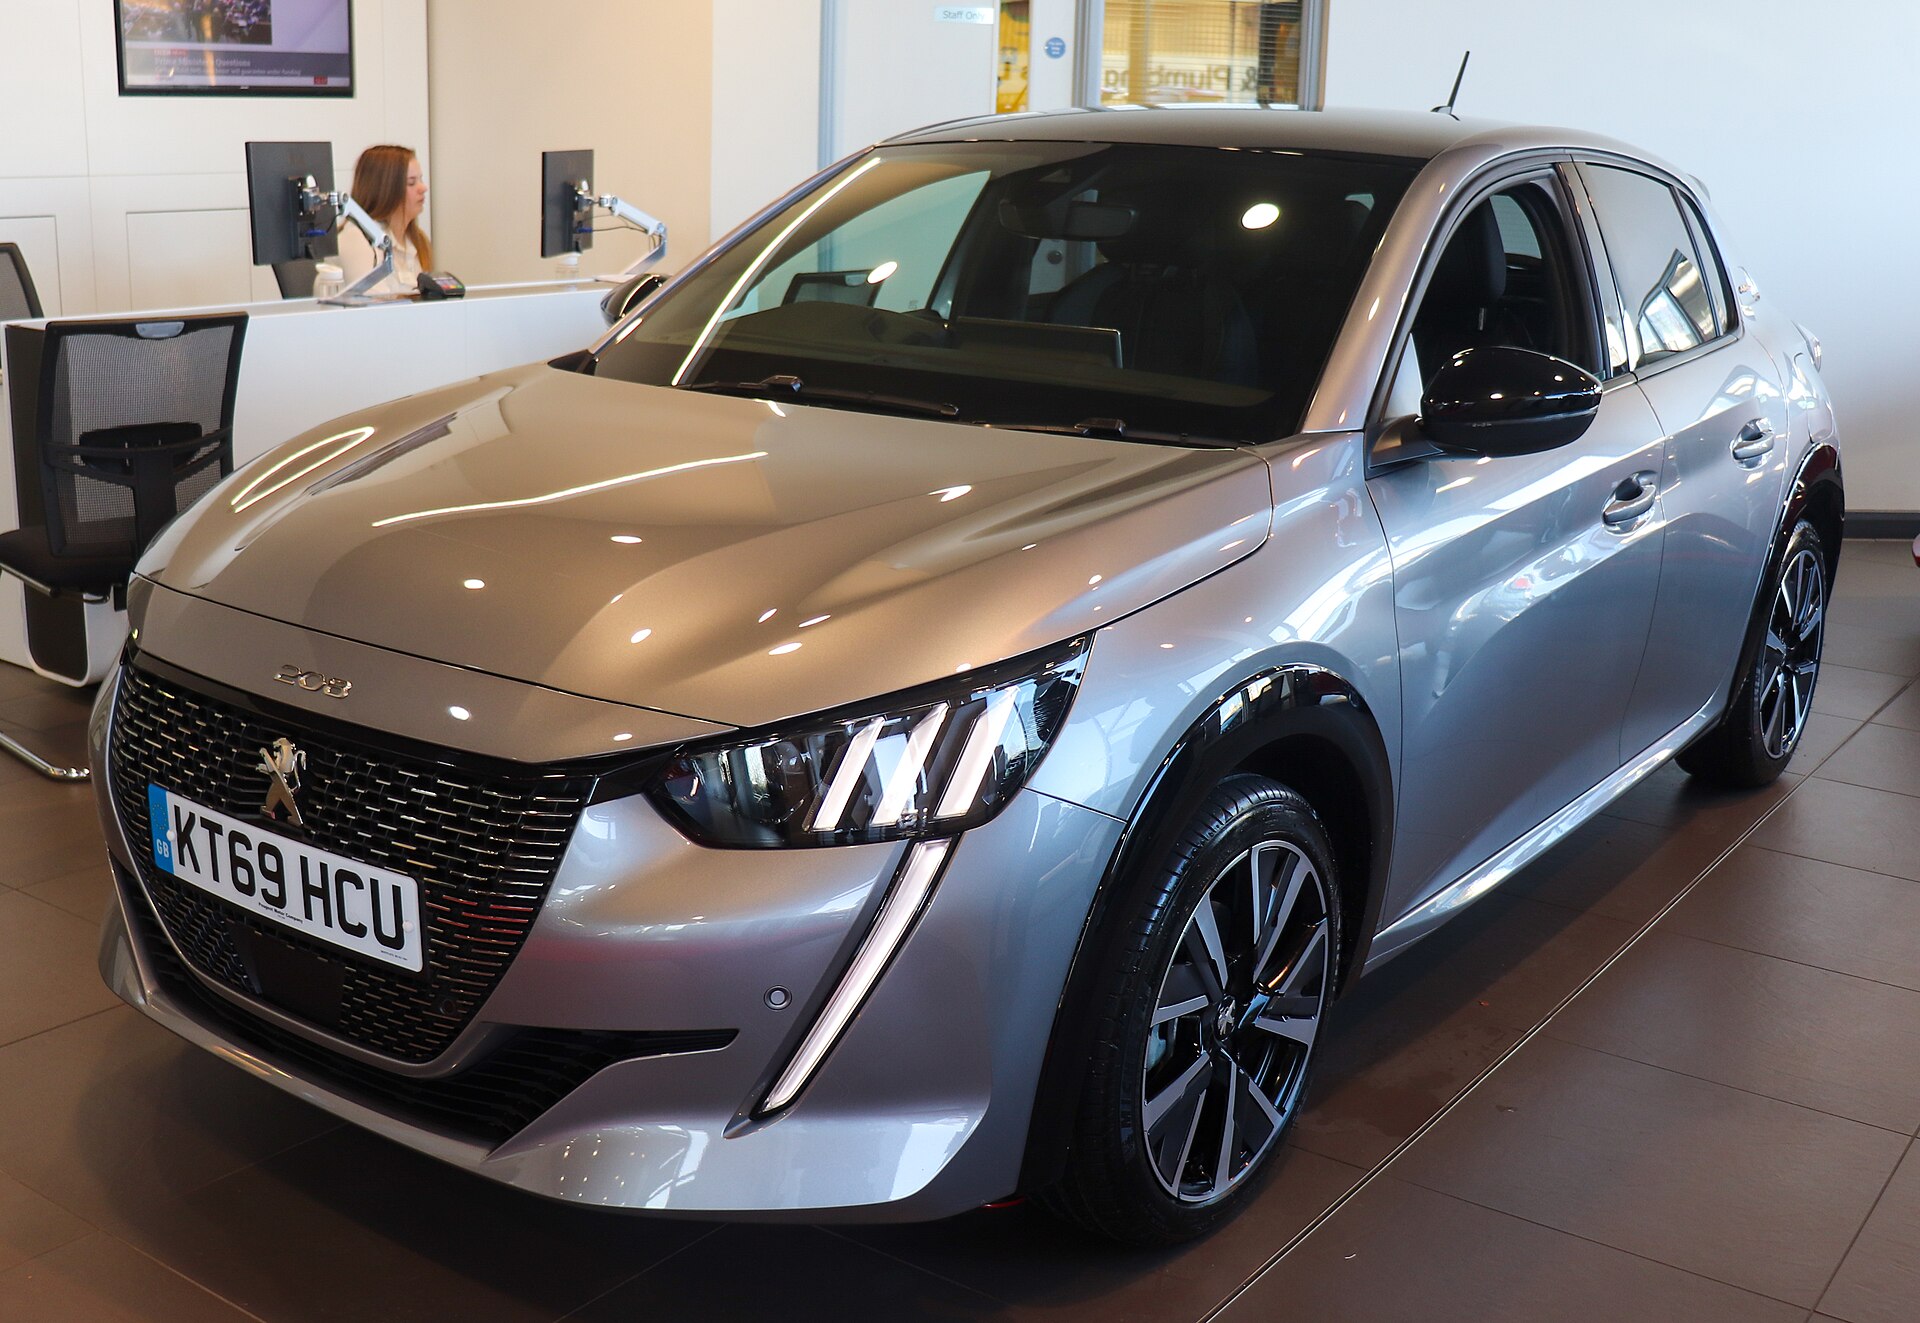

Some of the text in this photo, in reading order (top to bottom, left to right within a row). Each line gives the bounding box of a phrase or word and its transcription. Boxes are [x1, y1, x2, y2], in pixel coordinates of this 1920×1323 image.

[942, 10, 985, 22] Staff Only
[273, 664, 353, 699] 208
[156, 838, 170, 858] GB
[173, 804, 405, 951] KT69 HCU
